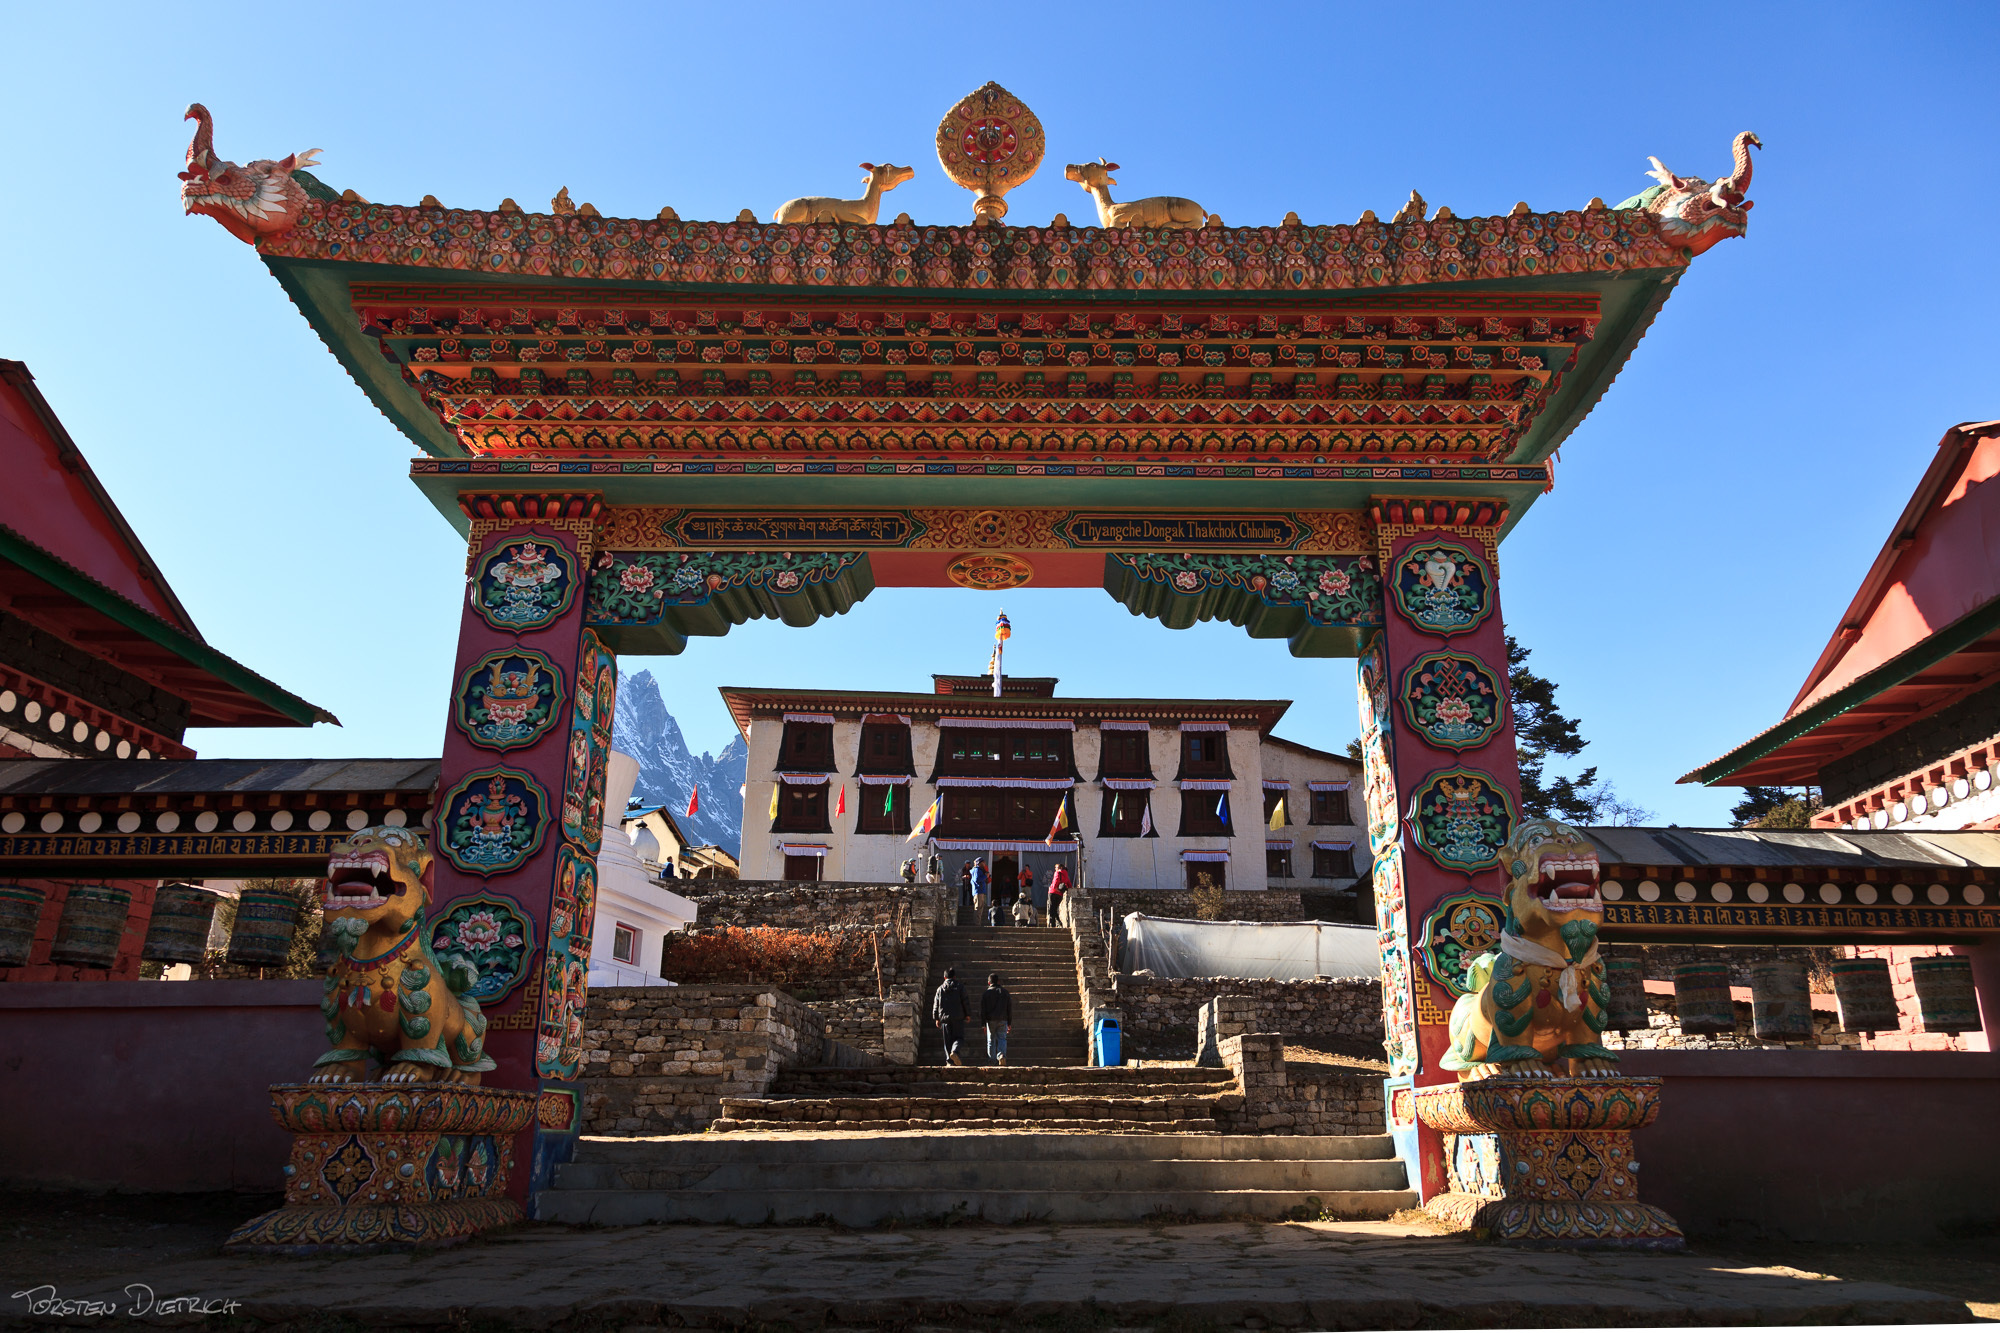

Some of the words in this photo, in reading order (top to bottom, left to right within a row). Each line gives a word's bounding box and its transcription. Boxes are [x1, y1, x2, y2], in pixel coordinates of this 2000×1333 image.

[1080, 520, 1142, 541] Thyangche
[1144, 521, 1185, 542] Dongak
[1187, 521, 1237, 539] Thakchok
[1239, 522, 1282, 543] Chholing
